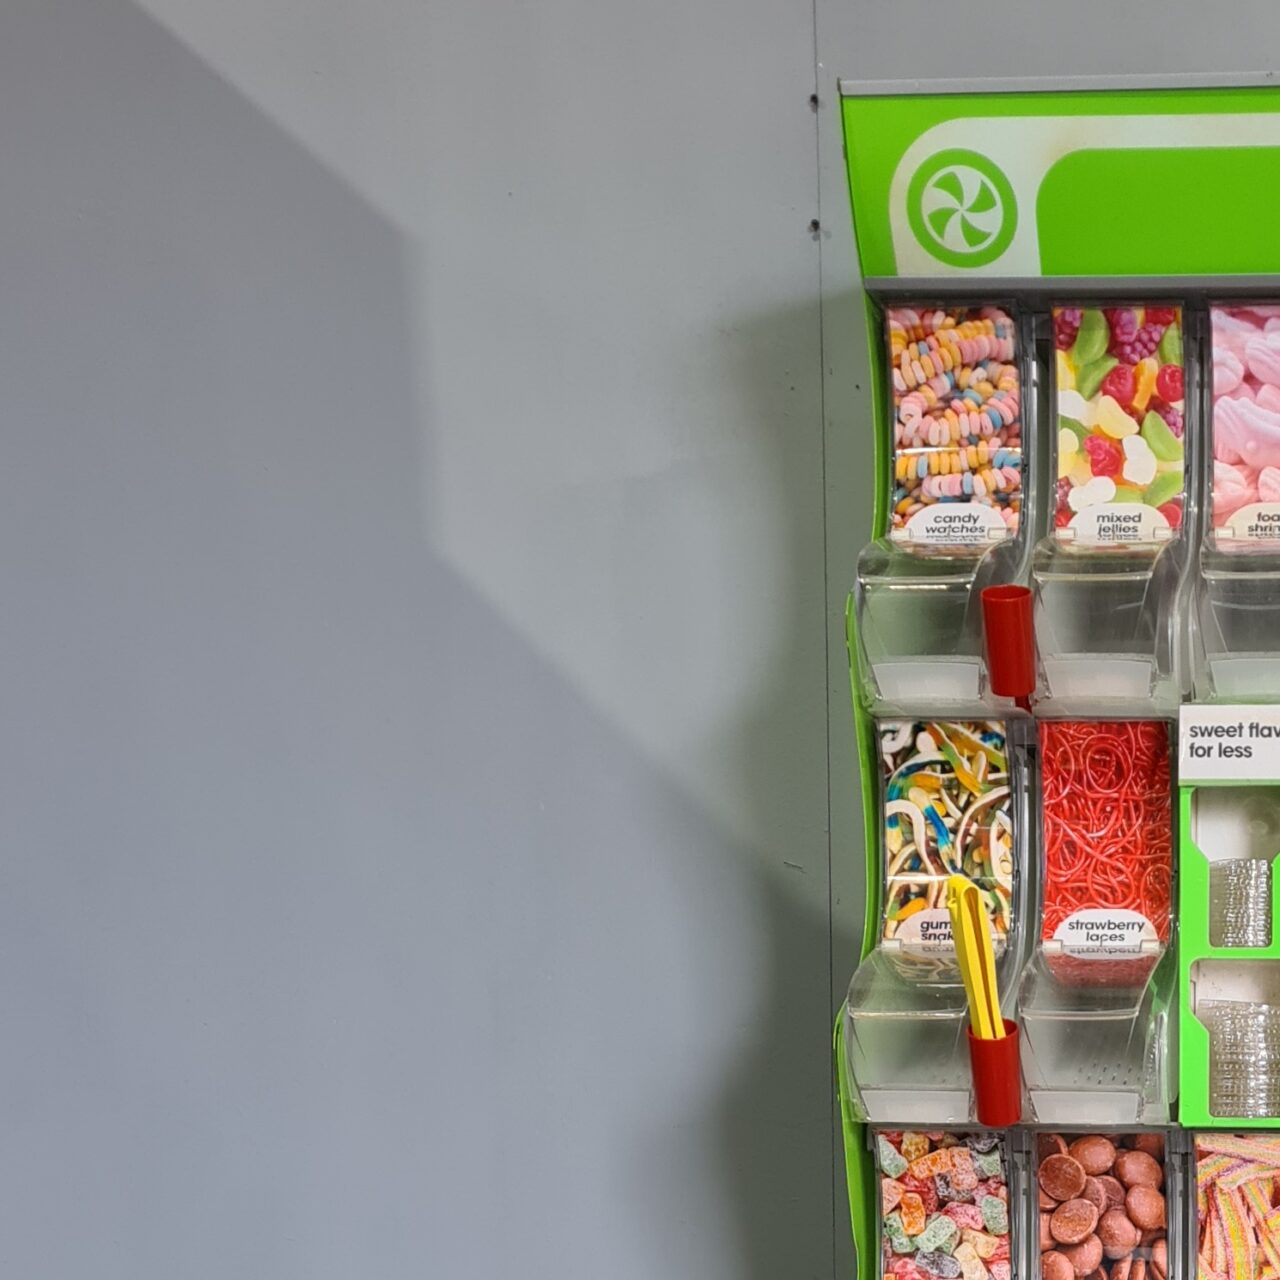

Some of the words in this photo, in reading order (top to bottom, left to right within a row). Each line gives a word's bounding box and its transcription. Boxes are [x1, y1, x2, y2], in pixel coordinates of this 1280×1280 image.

[933, 513, 980, 524] candy
[1096, 512, 1142, 523] mixed
[925, 524, 986, 534] watches
[1097, 524, 1139, 536] jellies
[1189, 724, 1245, 738] sweet
[1189, 742, 1215, 758] for
[1218, 742, 1253, 758] less
[920, 921, 952, 932] gum
[1067, 919, 1145, 931] strawberry
[921, 931, 955, 941] snak
[1086, 931, 1125, 941] laces
